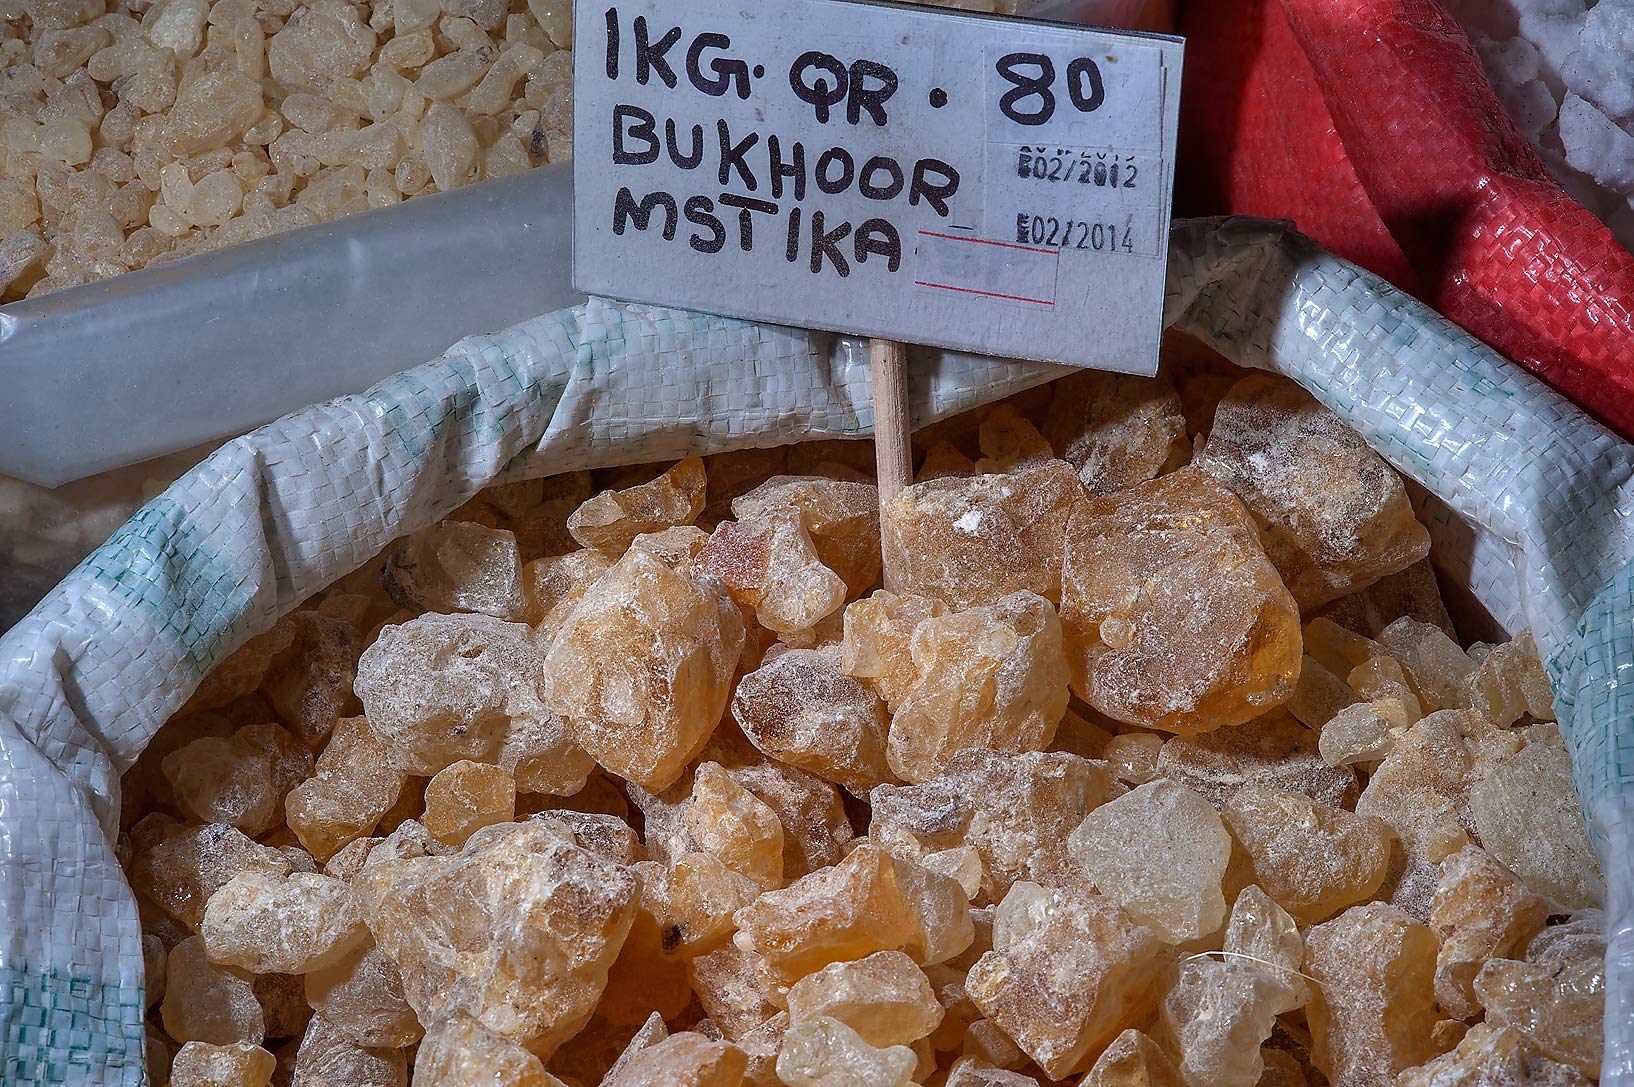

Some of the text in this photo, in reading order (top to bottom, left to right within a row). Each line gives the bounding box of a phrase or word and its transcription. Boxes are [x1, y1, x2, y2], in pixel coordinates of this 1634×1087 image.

[995, 52, 1105, 126] 80
[612, 103, 961, 217] BUKHOOR
[612, 186, 902, 278] MSTIKA
